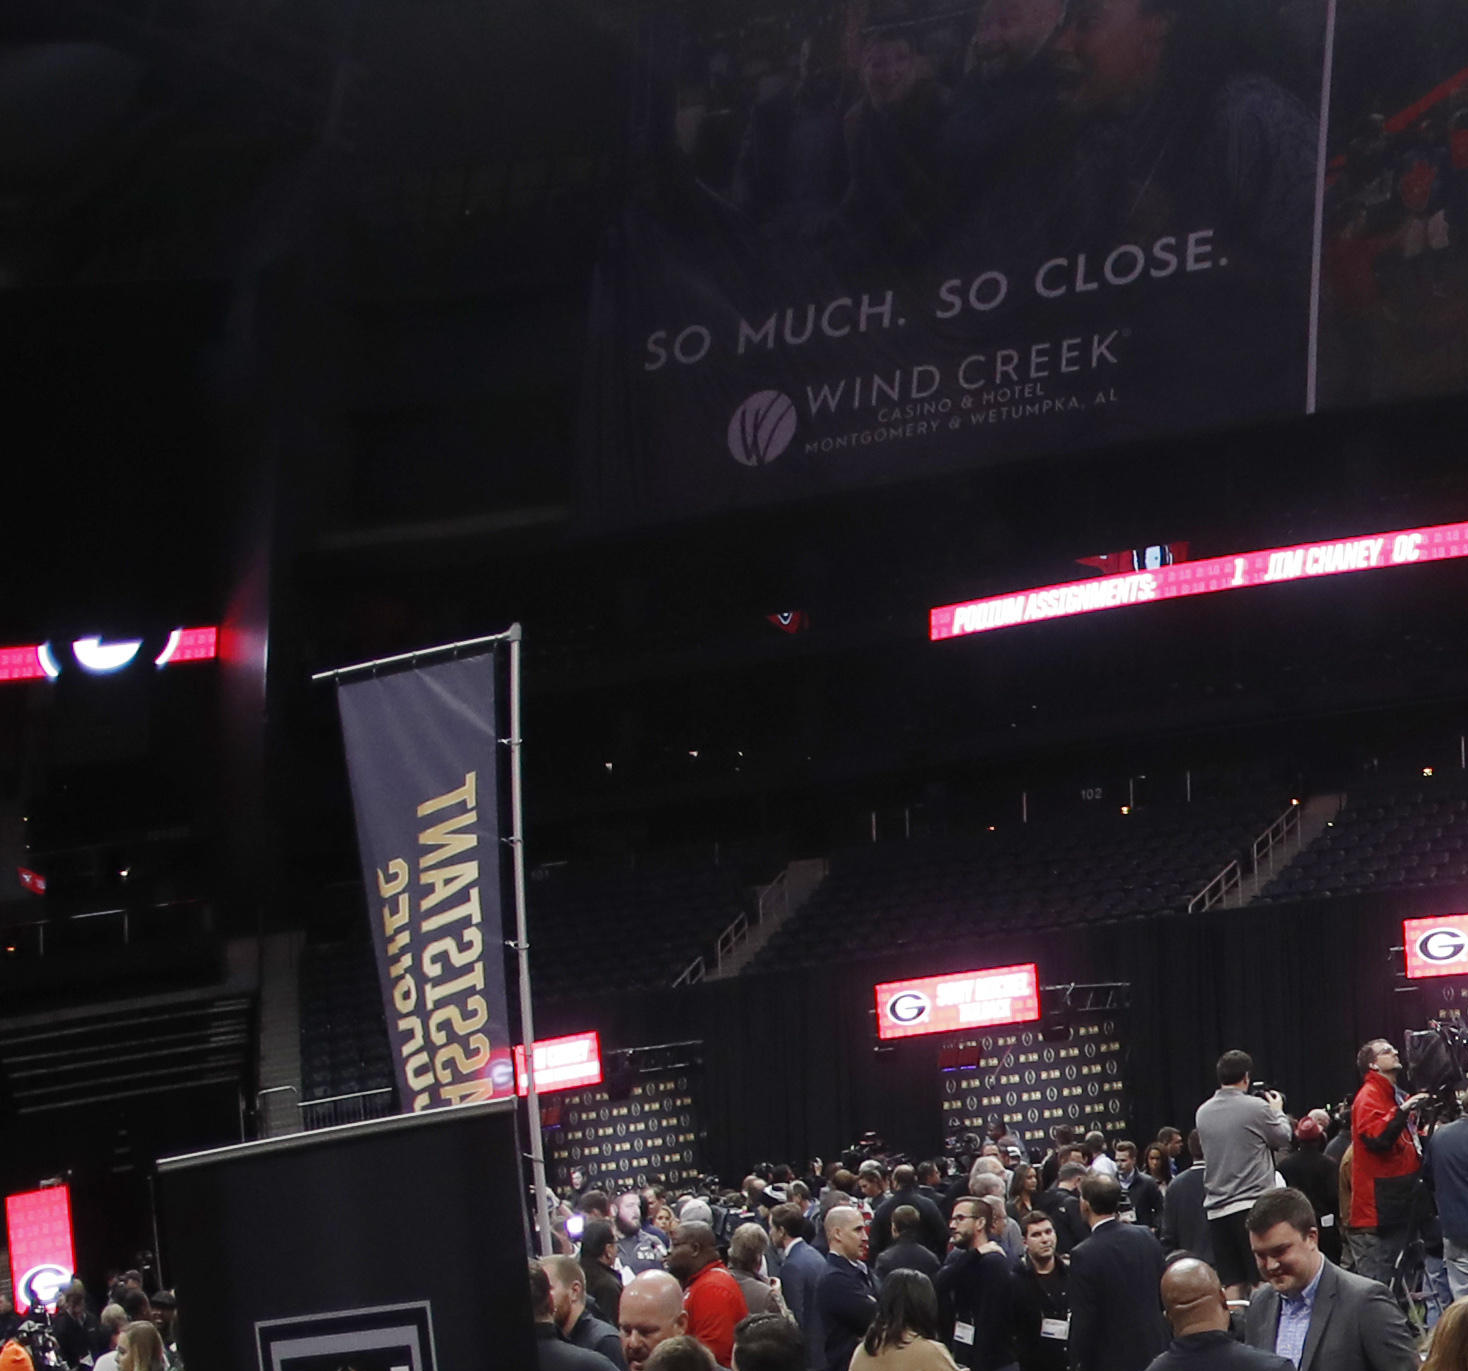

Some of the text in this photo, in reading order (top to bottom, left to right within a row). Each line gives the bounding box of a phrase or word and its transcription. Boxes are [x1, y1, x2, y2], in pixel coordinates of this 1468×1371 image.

[643, 229, 1230, 372] SO MUCH. SO CLOSE.
[805, 365, 942, 415] WIND
[878, 396, 952, 424] CASINO
[982, 381, 1046, 404] HOTEL
[804, 420, 941, 455] MONTGOMERY
[970, 395, 1086, 426] WETUMPKA,
[1094, 388, 1119, 404] AL
[951, 594, 1026, 635] PODIUM
[1025, 572, 1155, 623] ASSIGNMENTS:
[1231, 557, 1246, 586] 1
[1263, 549, 1304, 583] JIM
[1304, 536, 1383, 576] CHANEY
[1391, 533, 1423, 563] OC
[1080, 786, 1103, 801] 102
